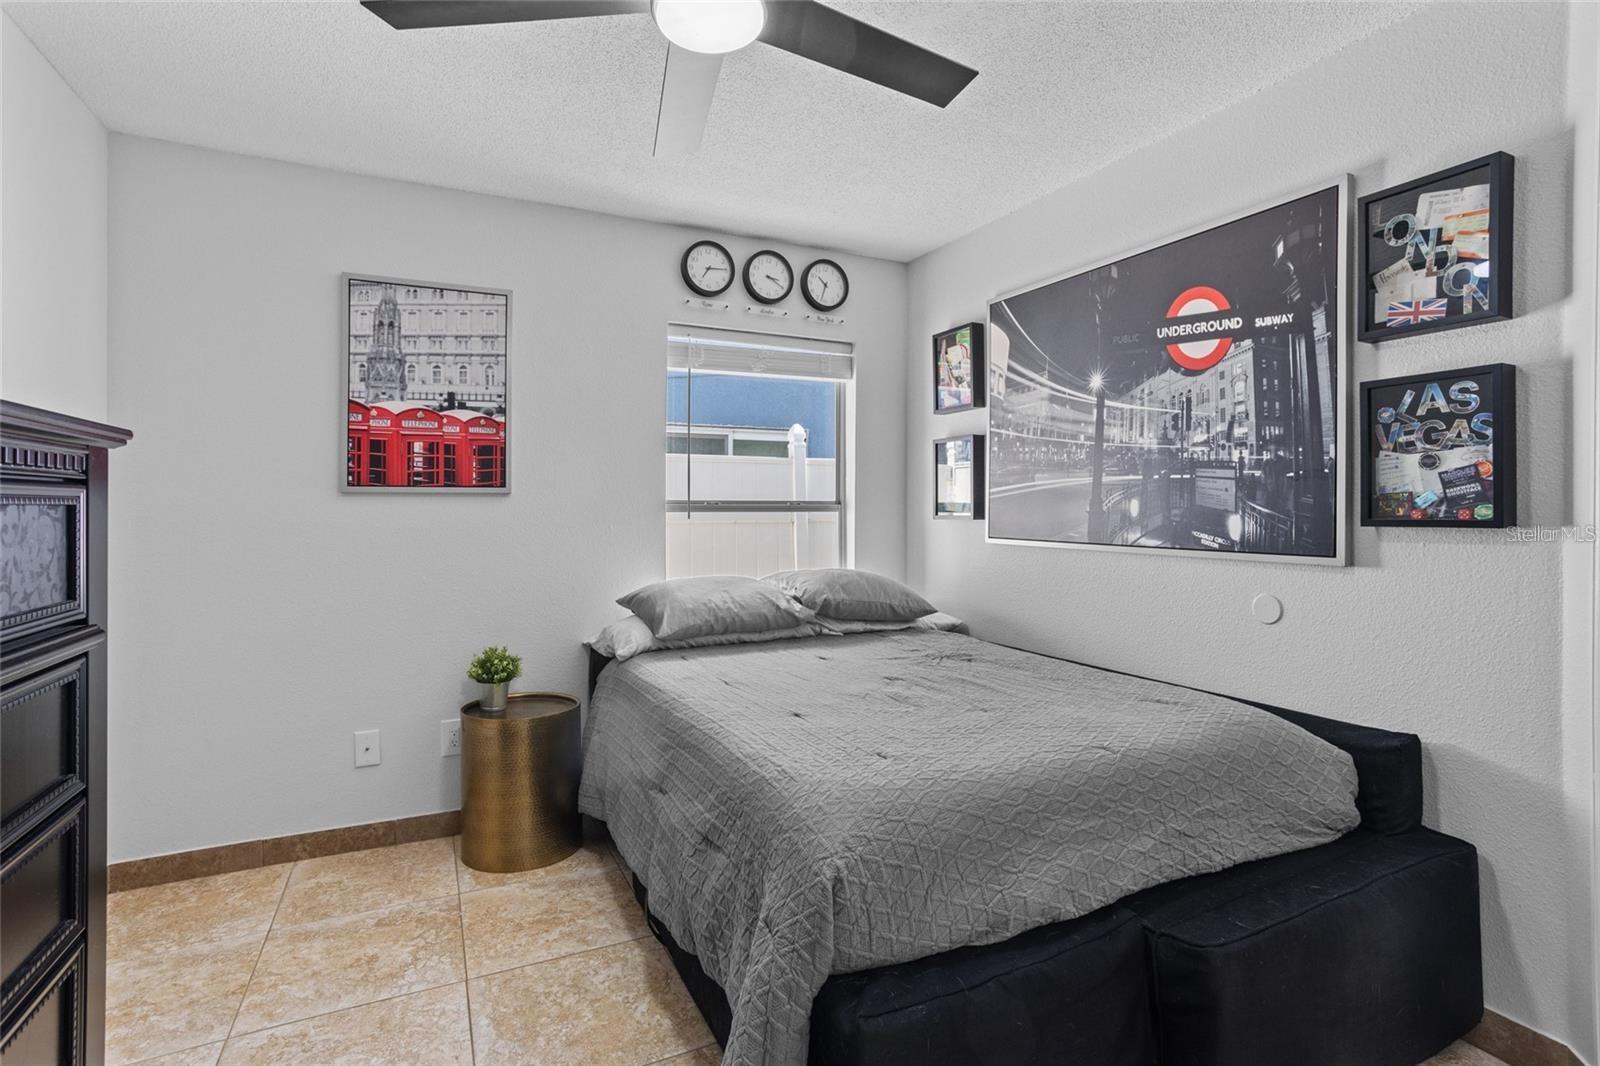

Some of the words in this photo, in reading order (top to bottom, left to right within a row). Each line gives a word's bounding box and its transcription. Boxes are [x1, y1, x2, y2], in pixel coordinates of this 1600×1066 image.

[1156, 317, 1243, 339] UNDERGROUND
[1254, 312, 1294, 327] SUBWAY
[1396, 380, 1481, 428] LAS
[1375, 412, 1493, 454] VEGAS
